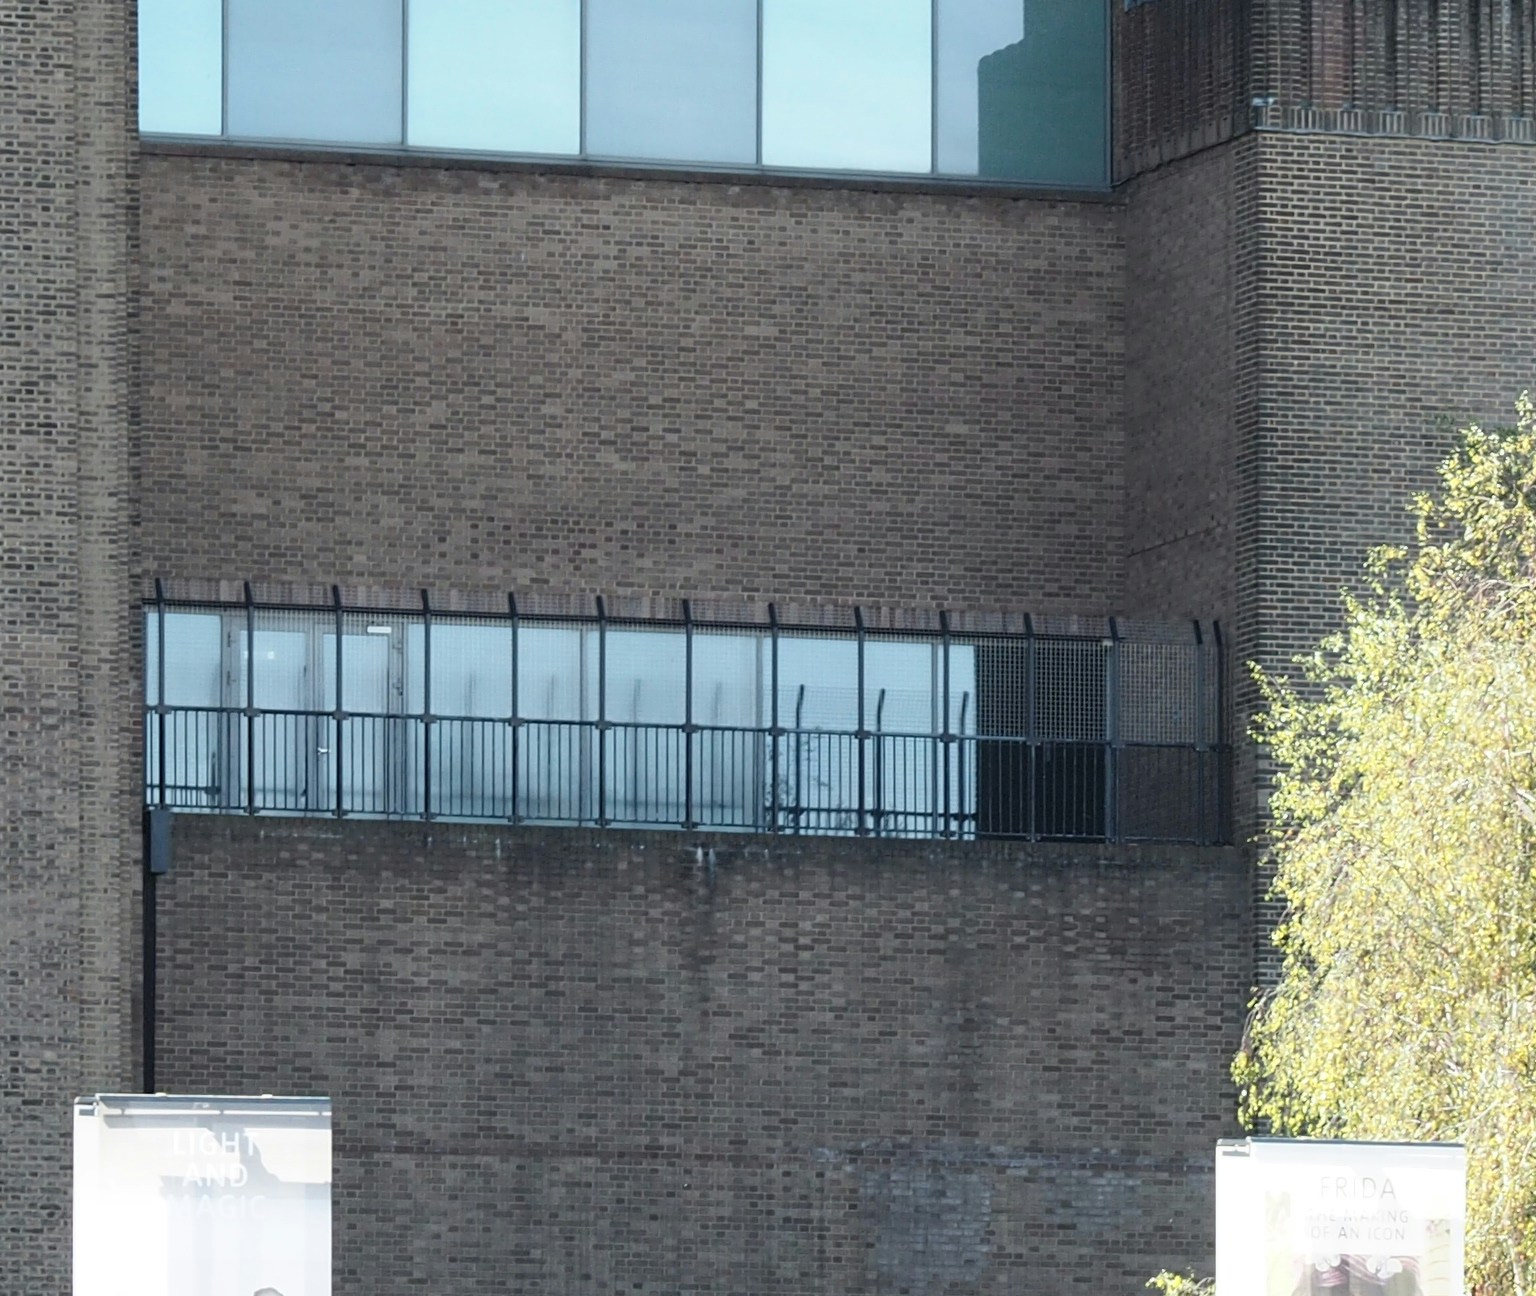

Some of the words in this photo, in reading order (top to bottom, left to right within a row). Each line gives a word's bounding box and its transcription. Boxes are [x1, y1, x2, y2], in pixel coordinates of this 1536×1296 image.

[173, 1131, 258, 1156] LIGHT
[183, 1161, 248, 1187] AND
[1321, 1176, 1396, 1199] FRIDA
[1338, 1226, 1359, 1240] AN
[1368, 1226, 1405, 1241] ICON
